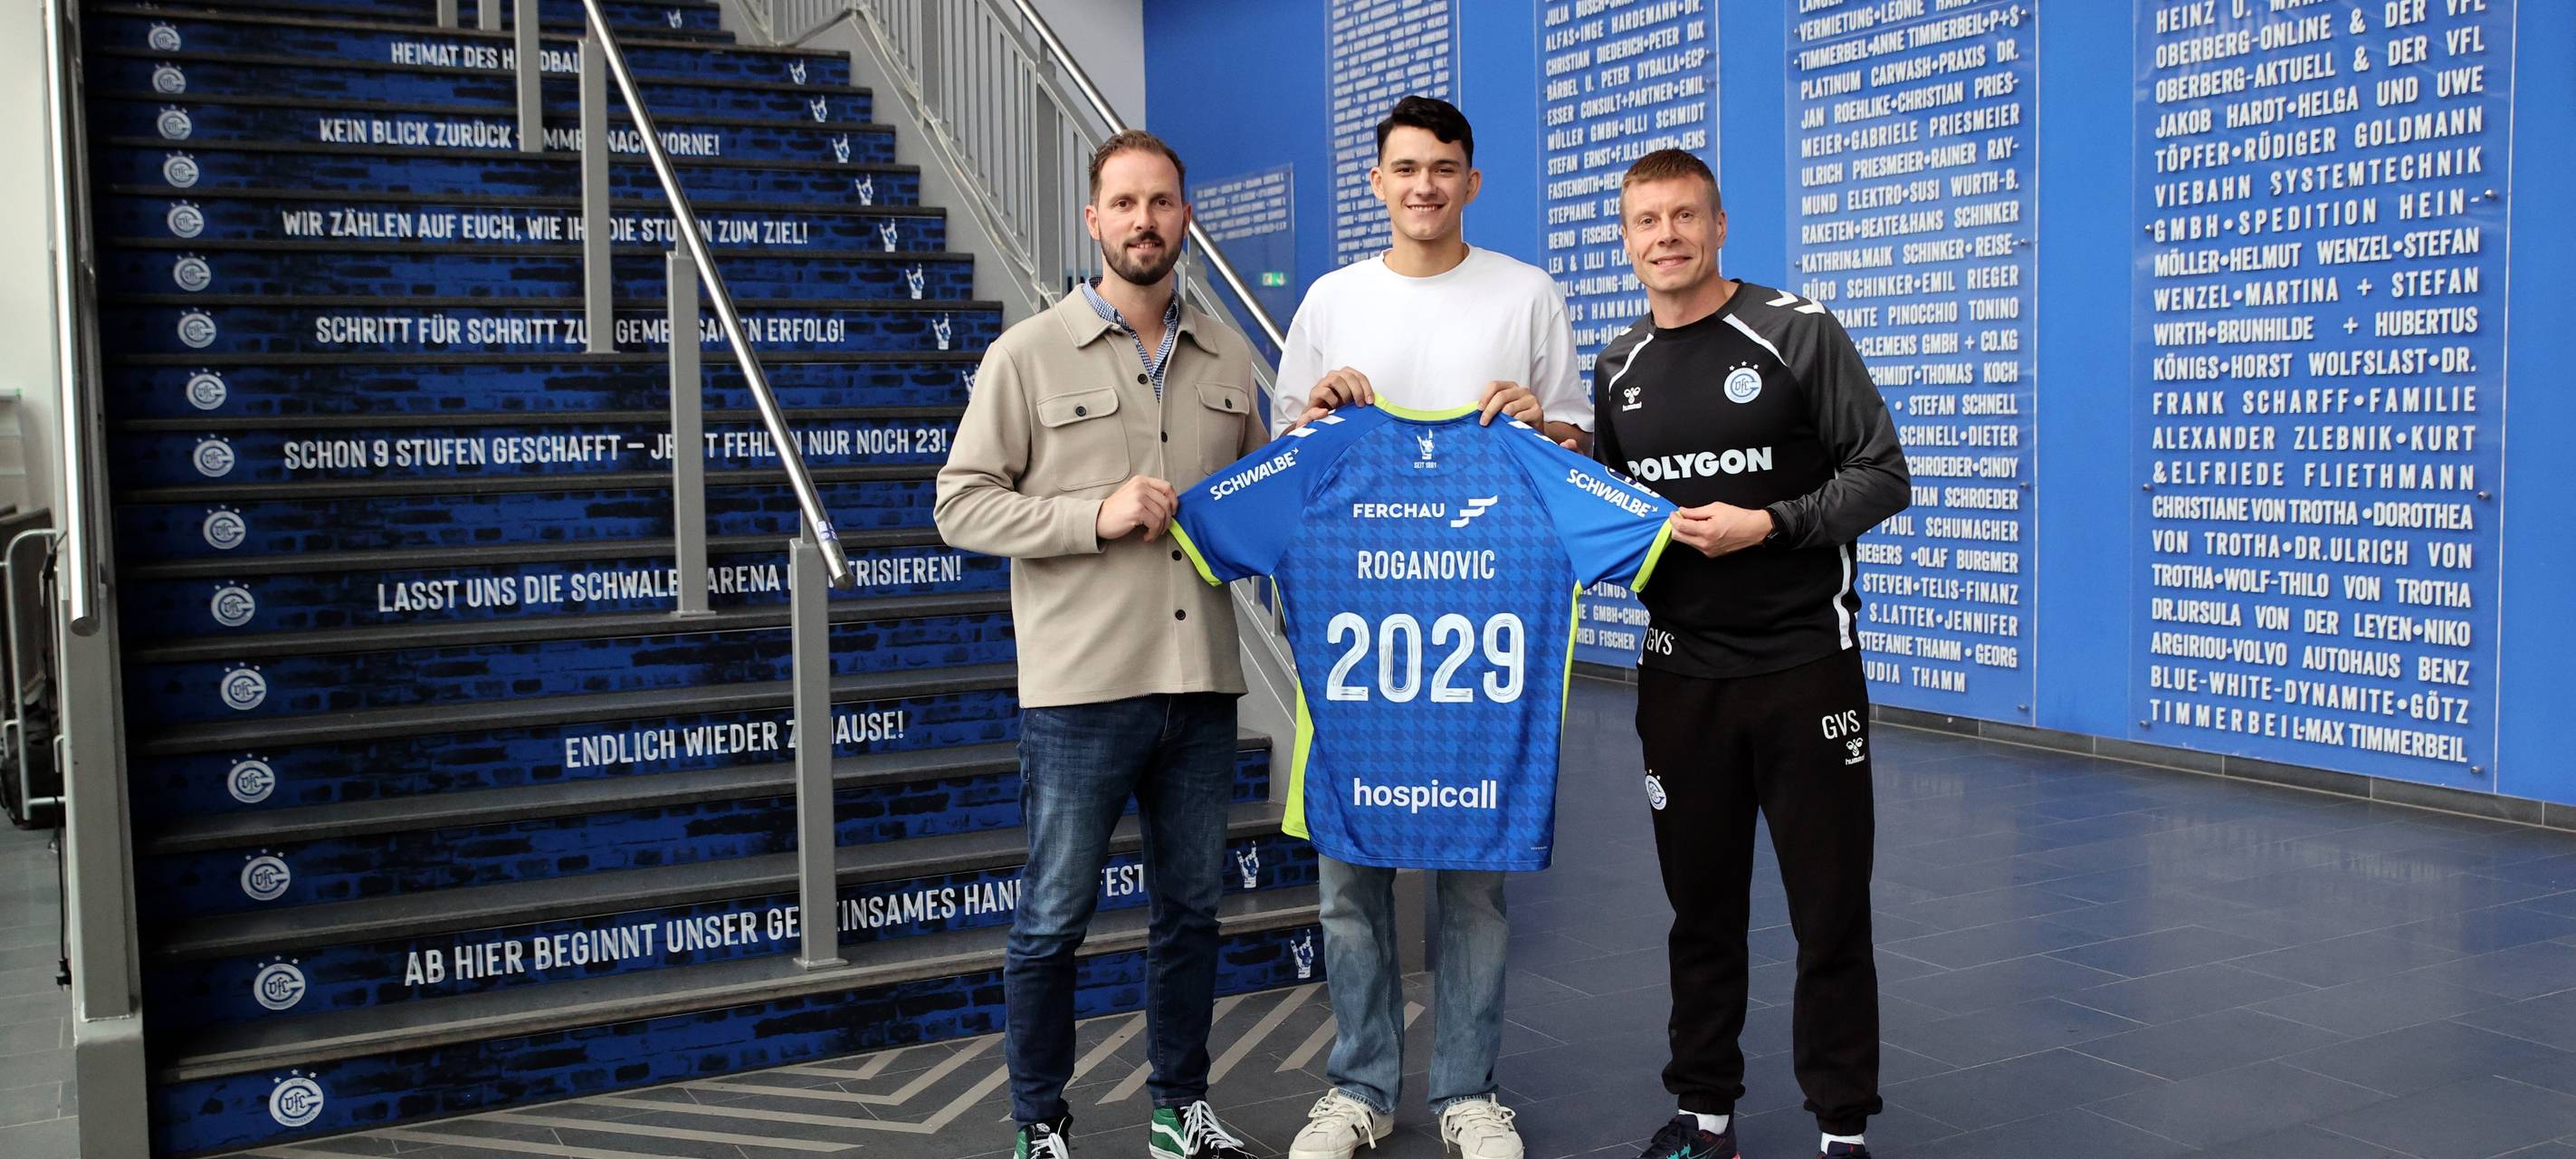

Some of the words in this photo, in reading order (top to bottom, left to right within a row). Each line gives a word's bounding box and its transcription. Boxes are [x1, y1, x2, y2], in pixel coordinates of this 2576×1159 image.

[2156, 14, 2331, 68] OBERBERG-ONLINE
[2350, 8, 2365, 34] &
[2386, 0, 2425, 27] DER
[2157, 0, 2214, 34] HEINZ
[391, 42, 459, 67] HEIMAT
[463, 46, 498, 69] DES
[1801, 71, 1860, 101] PLATINUM
[1997, 39, 2018, 62] DR.
[2156, 52, 2335, 103] OBERBERG-AKTUELL
[2353, 45, 2370, 72] &
[2389, 35, 2427, 66] DER
[2447, 25, 2485, 55] VFL
[1656, 101, 1705, 129] SCHMIDT
[1801, 107, 1824, 129] JAN
[1975, 72, 2018, 99] PRIES-
[2156, 109, 2211, 138] JAKOB
[2377, 77, 2418, 106] UND
[2438, 65, 2483, 97] UWE
[320, 118, 367, 143] KEIN
[372, 120, 430, 146] BLICK
[434, 120, 511, 148] ZURÜCK
[1930, 103, 2019, 138] PRIESMEIER
[2355, 106, 2482, 148] GOLDMANN
[1802, 163, 1842, 187] ULRICH
[1988, 137, 2018, 160] RAY-
[2155, 175, 2250, 206] VIEBAHN
[2271, 146, 2481, 195] SYSTEMTECHNIK
[1802, 193, 1837, 216] MUND
[1951, 168, 2018, 196] WURTH-B.
[2400, 188, 2479, 219] HEIN-
[281, 210, 324, 236] WIR
[329, 208, 412, 238] ZÄHLEN
[417, 213, 457, 239] AUF
[463, 215, 522, 243] EUCH,
[526, 216, 562, 240] WIE
[718, 220, 758, 244] ZUM
[764, 221, 808, 244] ZIEL!
[1954, 201, 2018, 227] SCHINKER
[1802, 246, 1892, 273] KATHRIN&MAIK
[1976, 234, 2018, 257] REISE-
[1803, 279, 1836, 303] BÜRO
[1968, 265, 2018, 289] RIEGER
[2357, 278, 2371, 295] +
[2392, 266, 2478, 297] STEFAN
[1888, 302, 1957, 325] PINOCCHIO
[1969, 297, 2018, 321] TONINO
[2343, 317, 2358, 333] +
[2375, 307, 2477, 336] HUBERTUS
[317, 317, 412, 344] SCHRITT
[417, 314, 462, 344] FÜR
[467, 318, 558, 344] SCHRITT
[768, 319, 845, 342] ERFOLG!
[1922, 333, 1958, 354] GMBH
[1981, 329, 2018, 351] CO.KG
[1984, 361, 2018, 382] KOCH
[1910, 395, 1955, 415] STEFAN
[1962, 394, 2018, 414] SCHNELL
[2153, 391, 2223, 414] FRANK
[283, 440, 367, 470] SCHON
[374, 440, 389, 467] 9
[396, 438, 486, 466] STUFEN
[492, 435, 621, 465] GESCHAFFT
[809, 429, 851, 455] NUR
[856, 428, 909, 455] NOCH
[915, 427, 947, 454] 23!
[2153, 426, 2275, 449] ALEXANDER
[1209, 452, 1296, 501] SCHWALBE
[1627, 446, 1773, 482] POLYGON
[2153, 461, 2284, 485] &ELFRIEDE
[2305, 463, 2474, 490] FLIETHMANN
[1566, 468, 1651, 518] SCHWALBE
[1945, 487, 2018, 509] SCHROEDER
[2152, 495, 2248, 521] CHRISTIANE
[2251, 498, 2285, 522] VON
[2289, 500, 2358, 524] TROTHA
[1353, 503, 1445, 518] FERCHAU
[1882, 515, 1914, 535] PAUL
[1926, 517, 2018, 541] SCHUMACHER
[1358, 550, 1495, 580] ROGANOVIC
[1957, 550, 2018, 573] BURGMER
[2152, 530, 2188, 552] VON
[2428, 542, 2472, 569] VON
[377, 580, 459, 613] LASST
[466, 576, 517, 608] UNS
[524, 574, 563, 604] DIE
[2343, 575, 2380, 600] VON
[2396, 579, 2471, 608] TROTHA
[2152, 598, 2241, 626] DR.URSULA
[2256, 606, 2289, 630] VON
[2304, 609, 2338, 635] DER
[1326, 611, 1524, 703] 2029
[1646, 627, 1674, 656] GVS
[1858, 631, 1913, 655] STEFANIE
[1915, 637, 1961, 661] THAMM
[1976, 644, 2017, 667] GEORG
[1912, 666, 1965, 692] THAMM
[2303, 646, 2400, 677] AUTOHAUS
[2419, 656, 2469, 685] BENZ
[1821, 709, 1861, 740] GVS
[565, 729, 677, 769] ENDLICH
[683, 721, 778, 758] WIEDER
[2349, 723, 2467, 762] TIMMERBEIL
[1354, 779, 1496, 813] hospicall
[405, 949, 445, 986] AB
[454, 939, 525, 981] HIER
[534, 923, 658, 970] BEGINNT
[666, 911, 758, 953] UNSER
